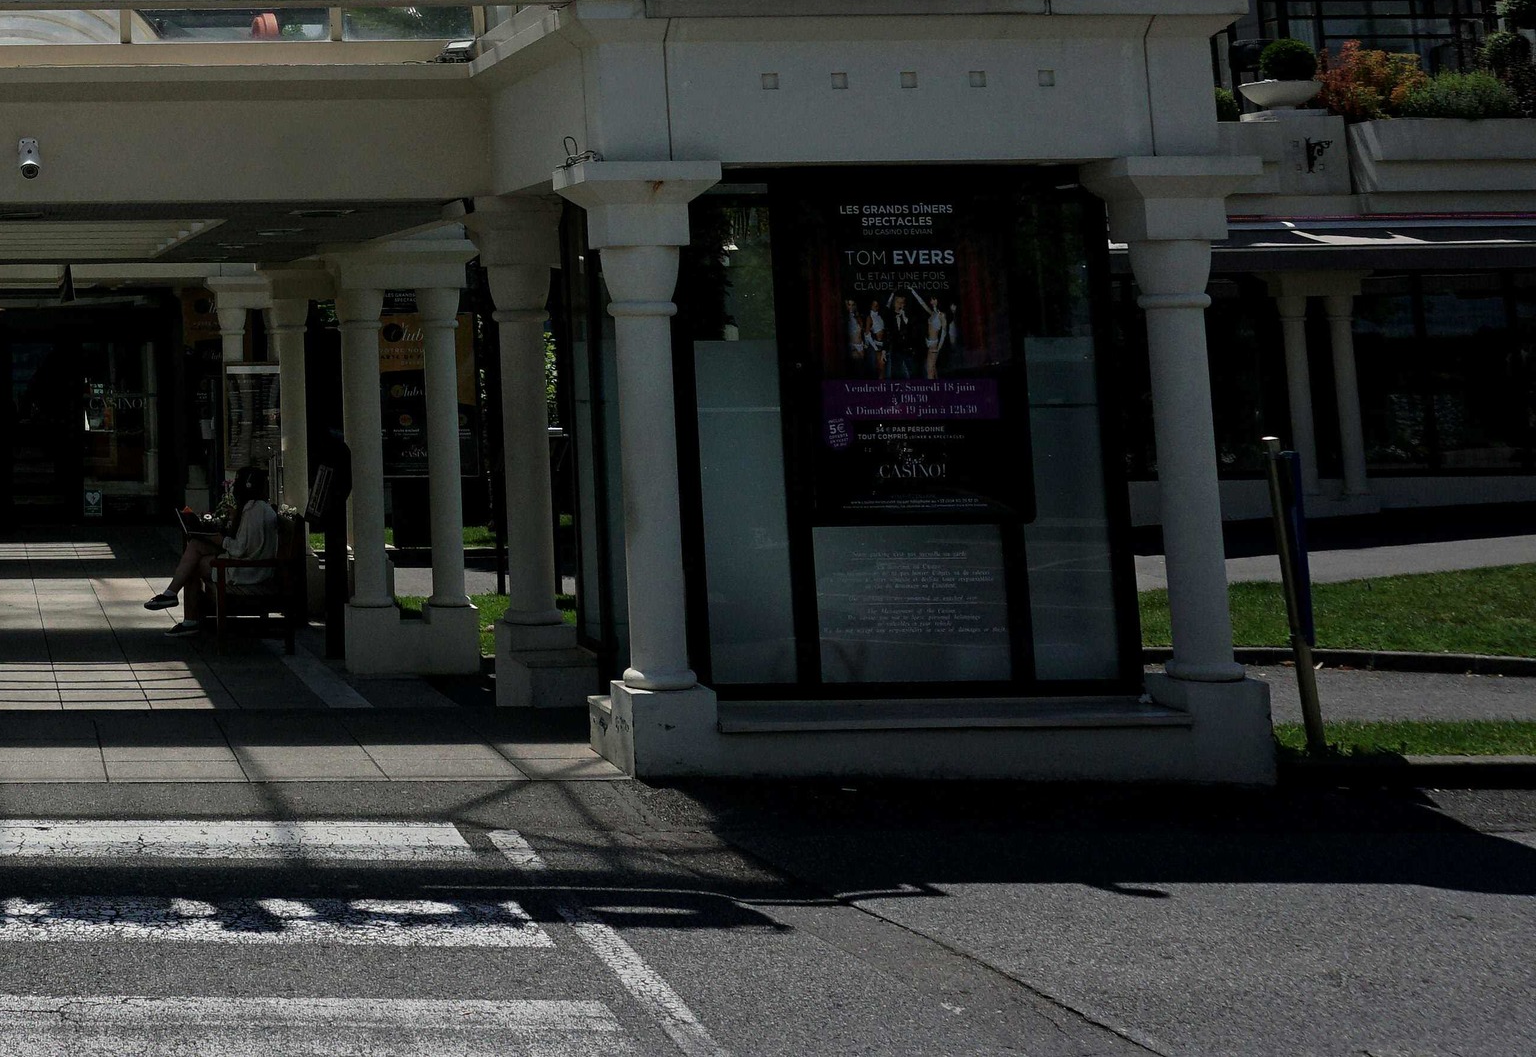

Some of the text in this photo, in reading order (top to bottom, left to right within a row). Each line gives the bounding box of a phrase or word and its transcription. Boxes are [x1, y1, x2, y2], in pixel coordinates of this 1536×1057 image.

[839, 202, 954, 215] LES GRANDS DÎNERS
[861, 216, 933, 227] SPECTACLES
[874, 228, 903, 236] CASINO
[845, 249, 956, 266] TOM EVERS
[856, 271, 866, 281] IL
[897, 271, 921, 281] UNE
[922, 271, 947, 281] FOIS
[854, 281, 895, 292] CLAUDE
[844, 383, 887, 393] Vendredi
[904, 382, 941, 392] Samedi
[944, 382, 955, 392] 18
[956, 382, 976, 394] juin
[88, 394, 149, 411] CASINO!
[846, 406, 854, 416] &
[905, 405, 916, 415] 19
[916, 405, 940, 418] juin
[940, 405, 947, 415] à
[948, 404, 978, 415] 12h30
[829, 423, 846, 434] 5€
[907, 425, 946, 433] PERSONNE
[877, 433, 909, 441] COMPRIS
[879, 463, 946, 479] CASINO!
